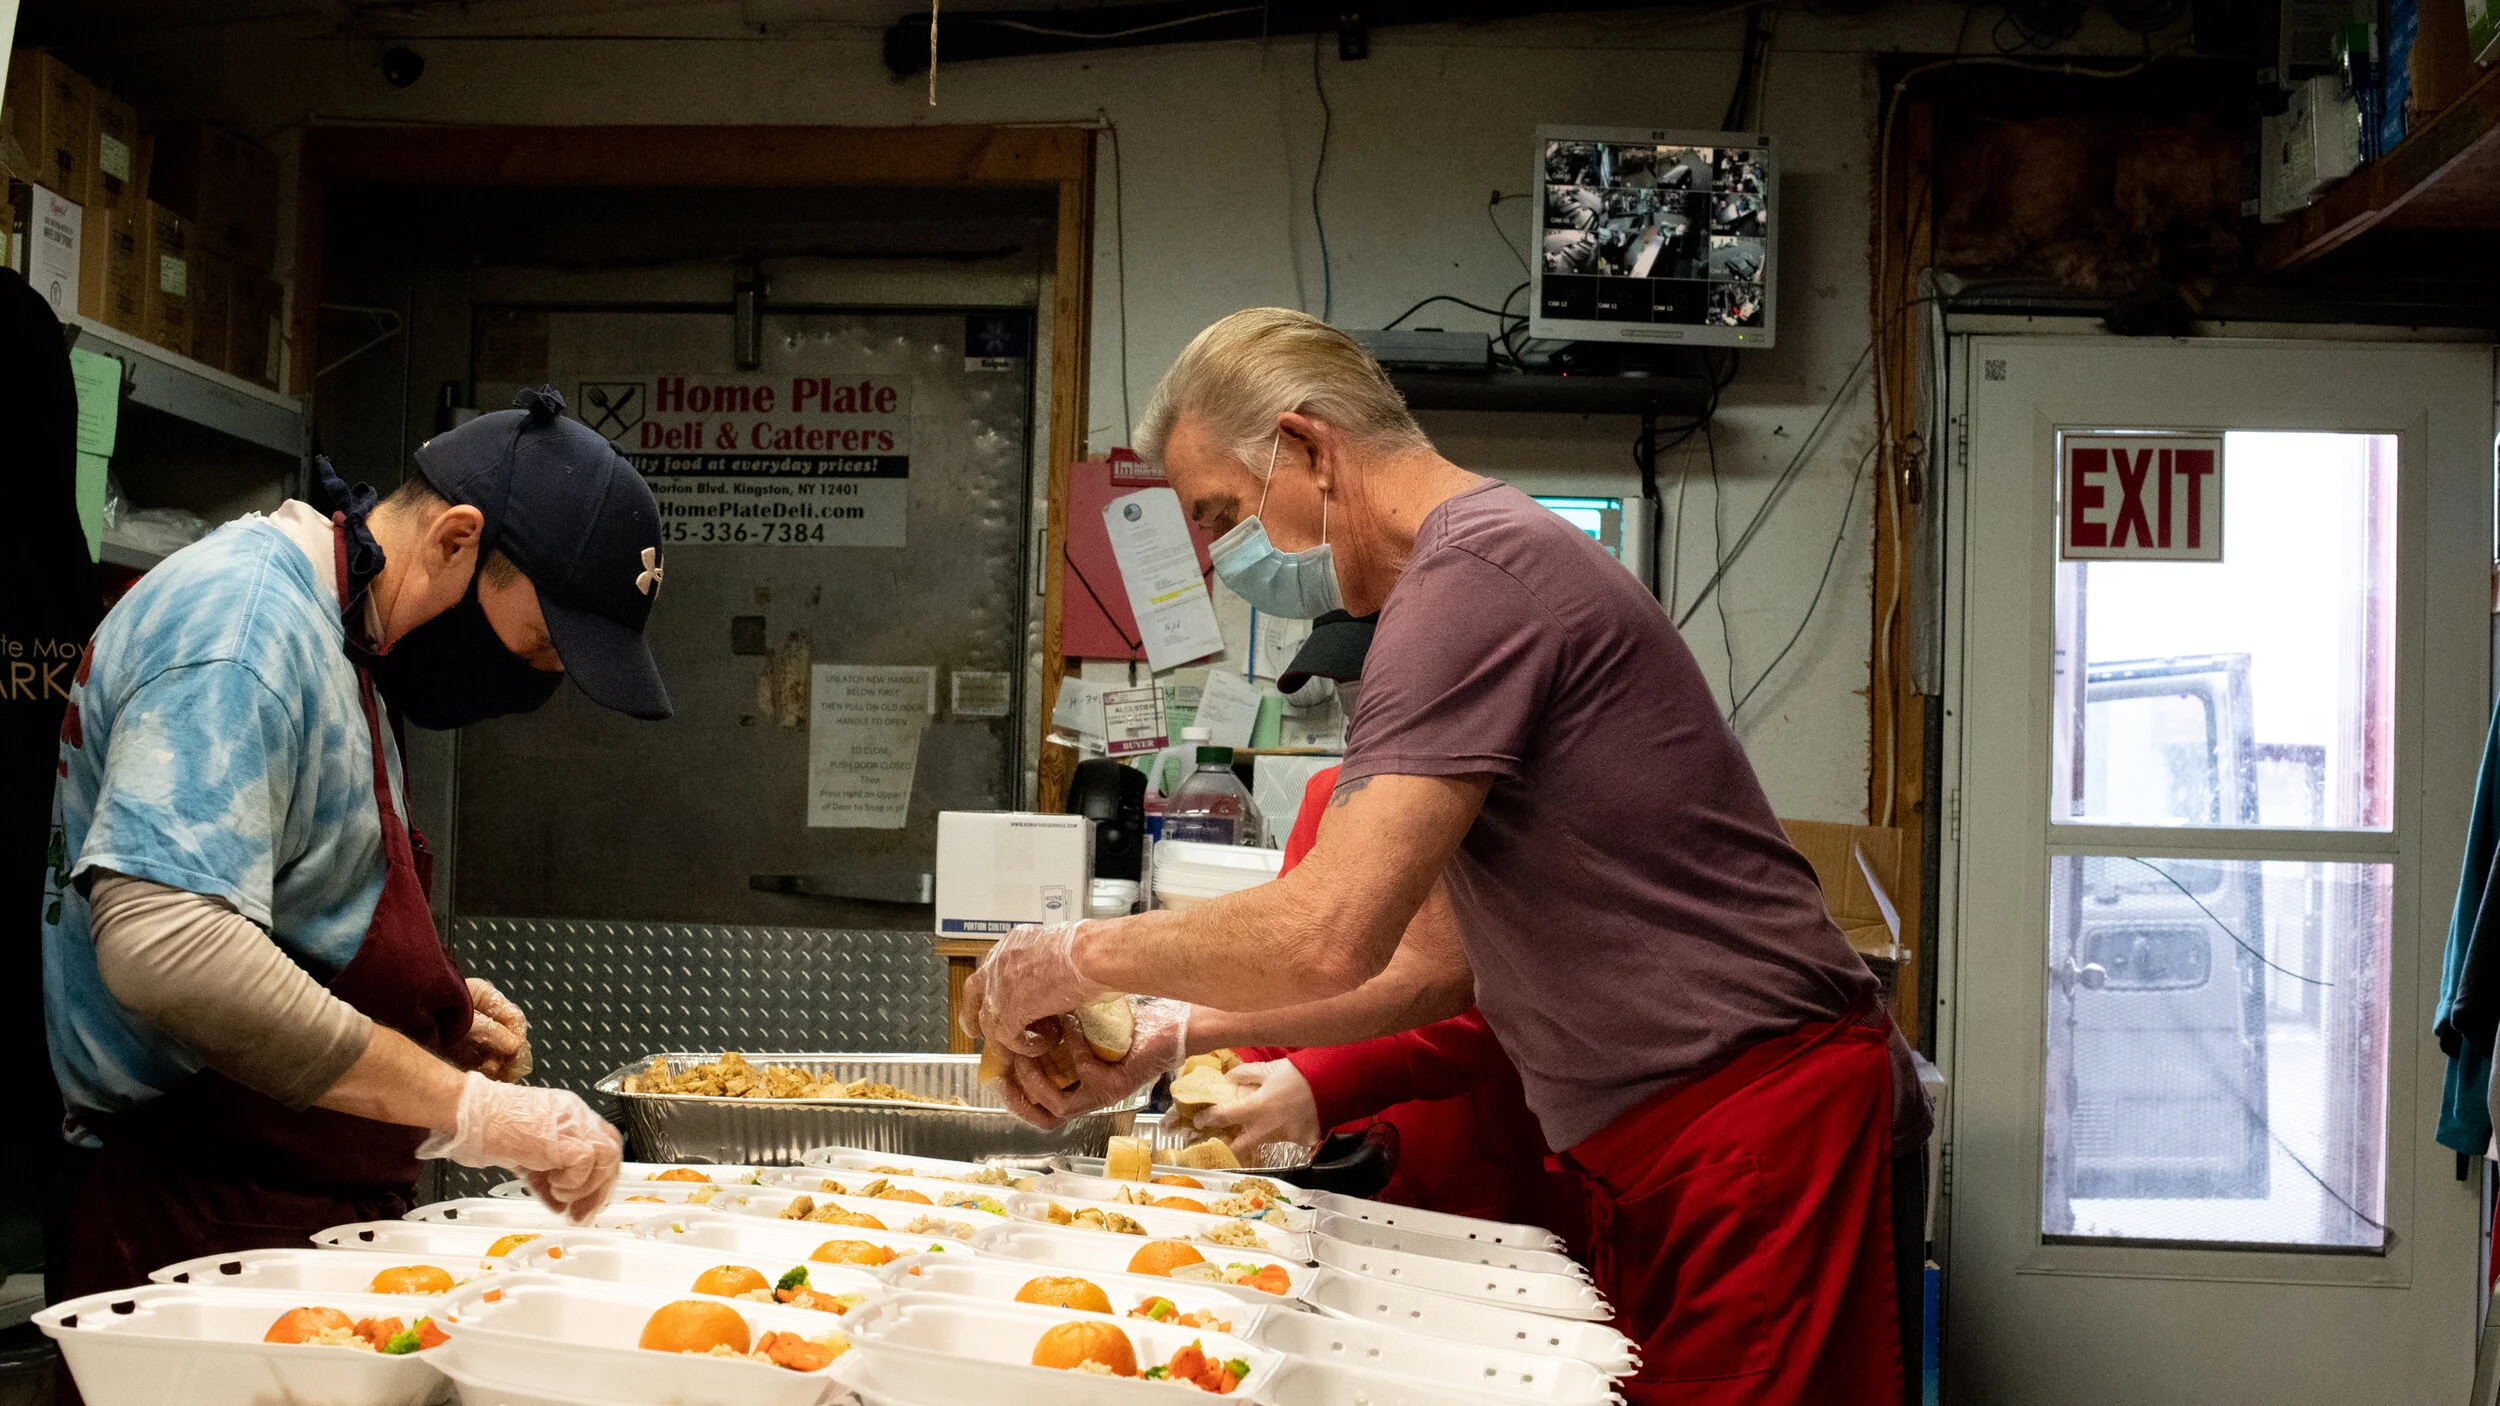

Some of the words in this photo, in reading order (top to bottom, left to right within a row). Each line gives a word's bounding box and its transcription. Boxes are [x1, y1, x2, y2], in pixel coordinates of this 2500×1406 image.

[656, 377, 774, 413] Home
[792, 377, 897, 414] Plate
[640, 421, 703, 450] Deli
[715, 422, 738, 451] &
[751, 422, 894, 451] Caterers
[664, 456, 701, 473] food
[708, 457, 725, 471] at
[731, 457, 812, 474] everyday
[818, 458, 878, 474] prices!
[697, 483, 728, 495] Blvd.
[733, 484, 793, 497] Kingston,
[798, 484, 815, 495] NY
[820, 484, 858, 495] 12401
[2071, 448, 2214, 549] EXIT
[659, 502, 864, 519] HomePlateDeli.com
[0, 661, 69, 701] RK
[821, 702, 844, 711] THEN
[865, 703, 879, 712] ON
[880, 703, 898, 712] OLD
[836, 717, 871, 726] HANDLE
[872, 718, 883, 726] TO
[884, 718, 908, 726] OPEN
[1122, 739, 1155, 750] BUYER
